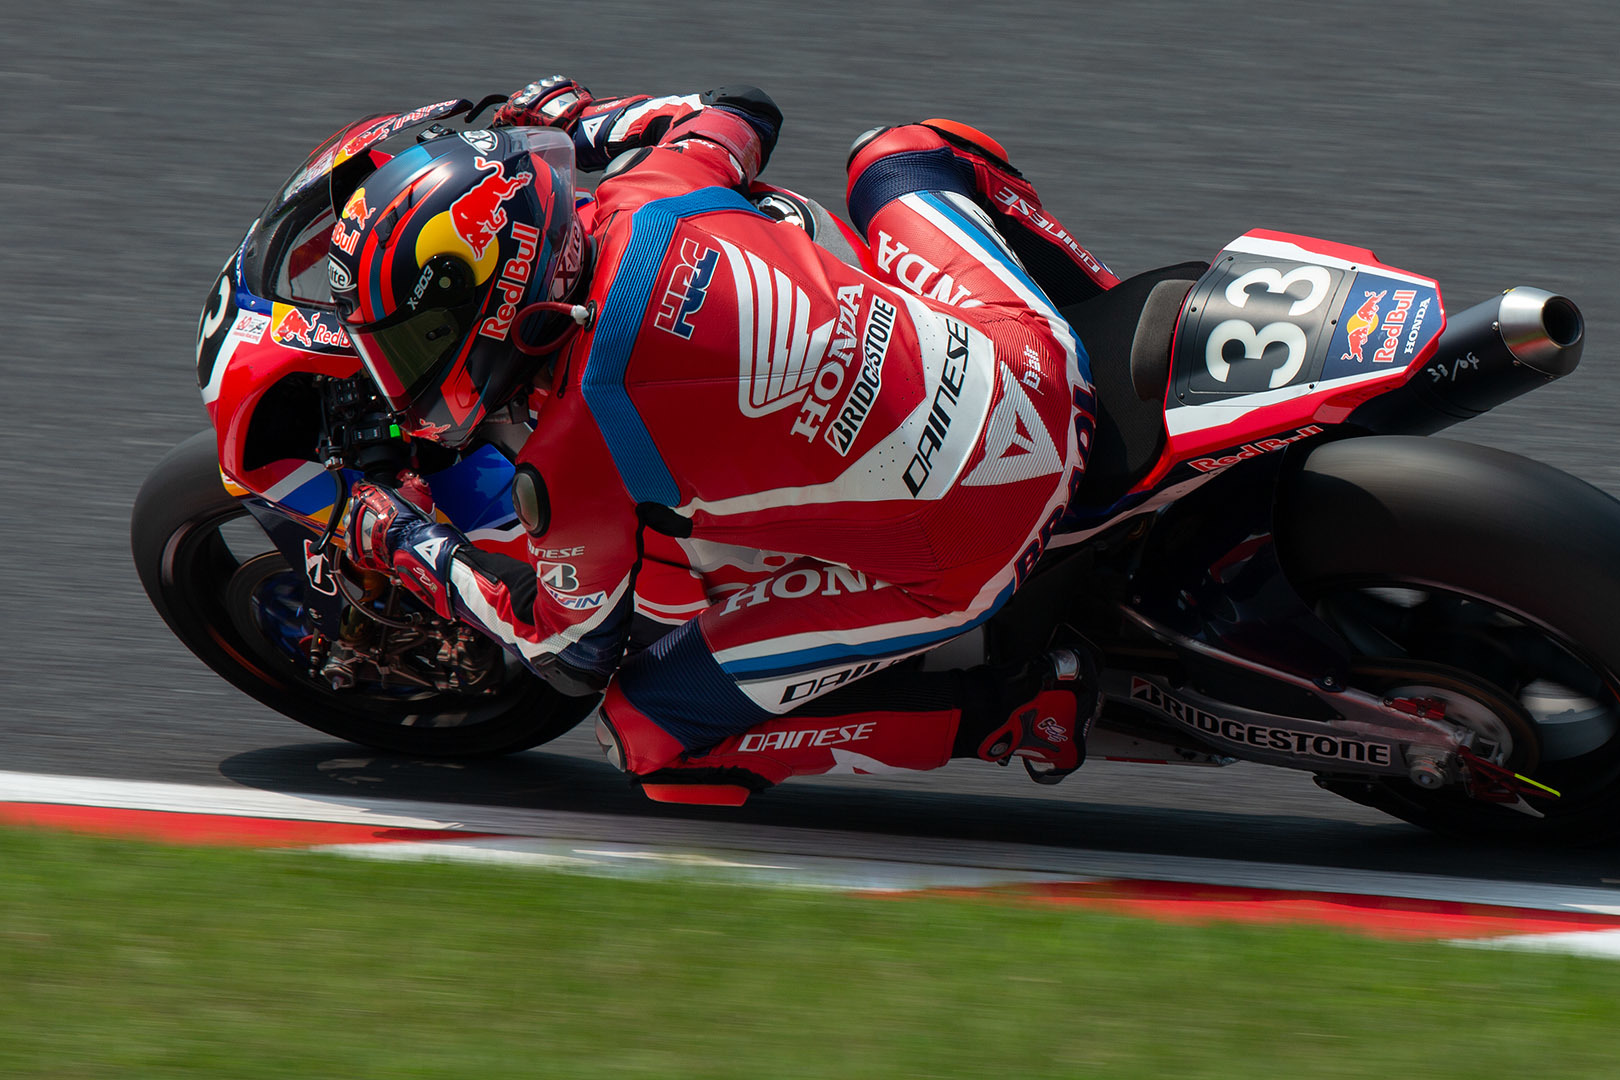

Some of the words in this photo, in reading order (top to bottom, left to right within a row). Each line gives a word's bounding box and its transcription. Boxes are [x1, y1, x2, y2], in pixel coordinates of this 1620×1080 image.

[995, 186, 1100, 273] DAINESE
[407, 265, 435, 310] X-803
[655, 237, 720, 339] HRC
[1205, 264, 1331, 389] 33
[1404, 297, 1431, 354] HONDA
[790, 283, 864, 443] HONDA
[828, 296, 893, 454] BRIDGESTONE
[902, 318, 968, 498] DAINESE
[737, 720, 878, 753] DAINESE
[1130, 675, 1392, 767] BRIDGESTONE
